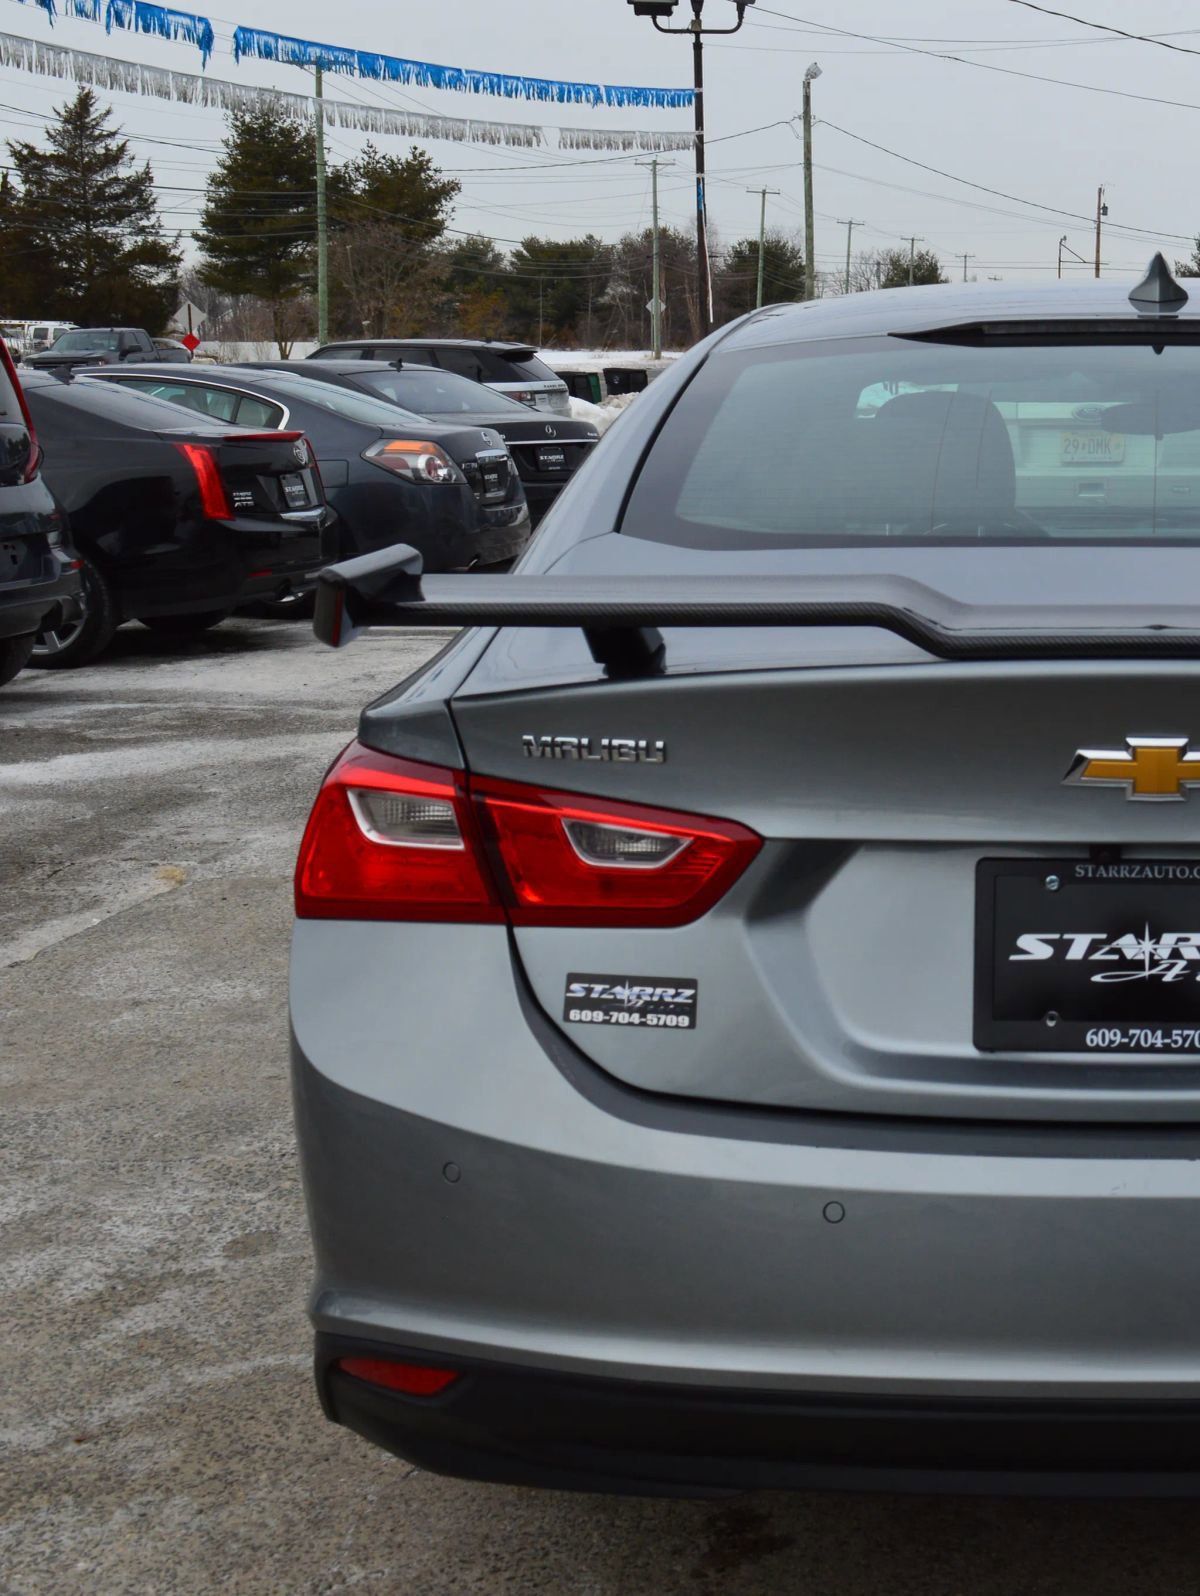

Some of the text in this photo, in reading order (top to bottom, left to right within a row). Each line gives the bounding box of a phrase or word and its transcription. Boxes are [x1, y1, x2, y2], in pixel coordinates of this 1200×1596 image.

[522, 735, 665, 763] MALIBU
[566, 982, 696, 1003] STARRZ
[569, 1009, 690, 1027] 609-704-5709
